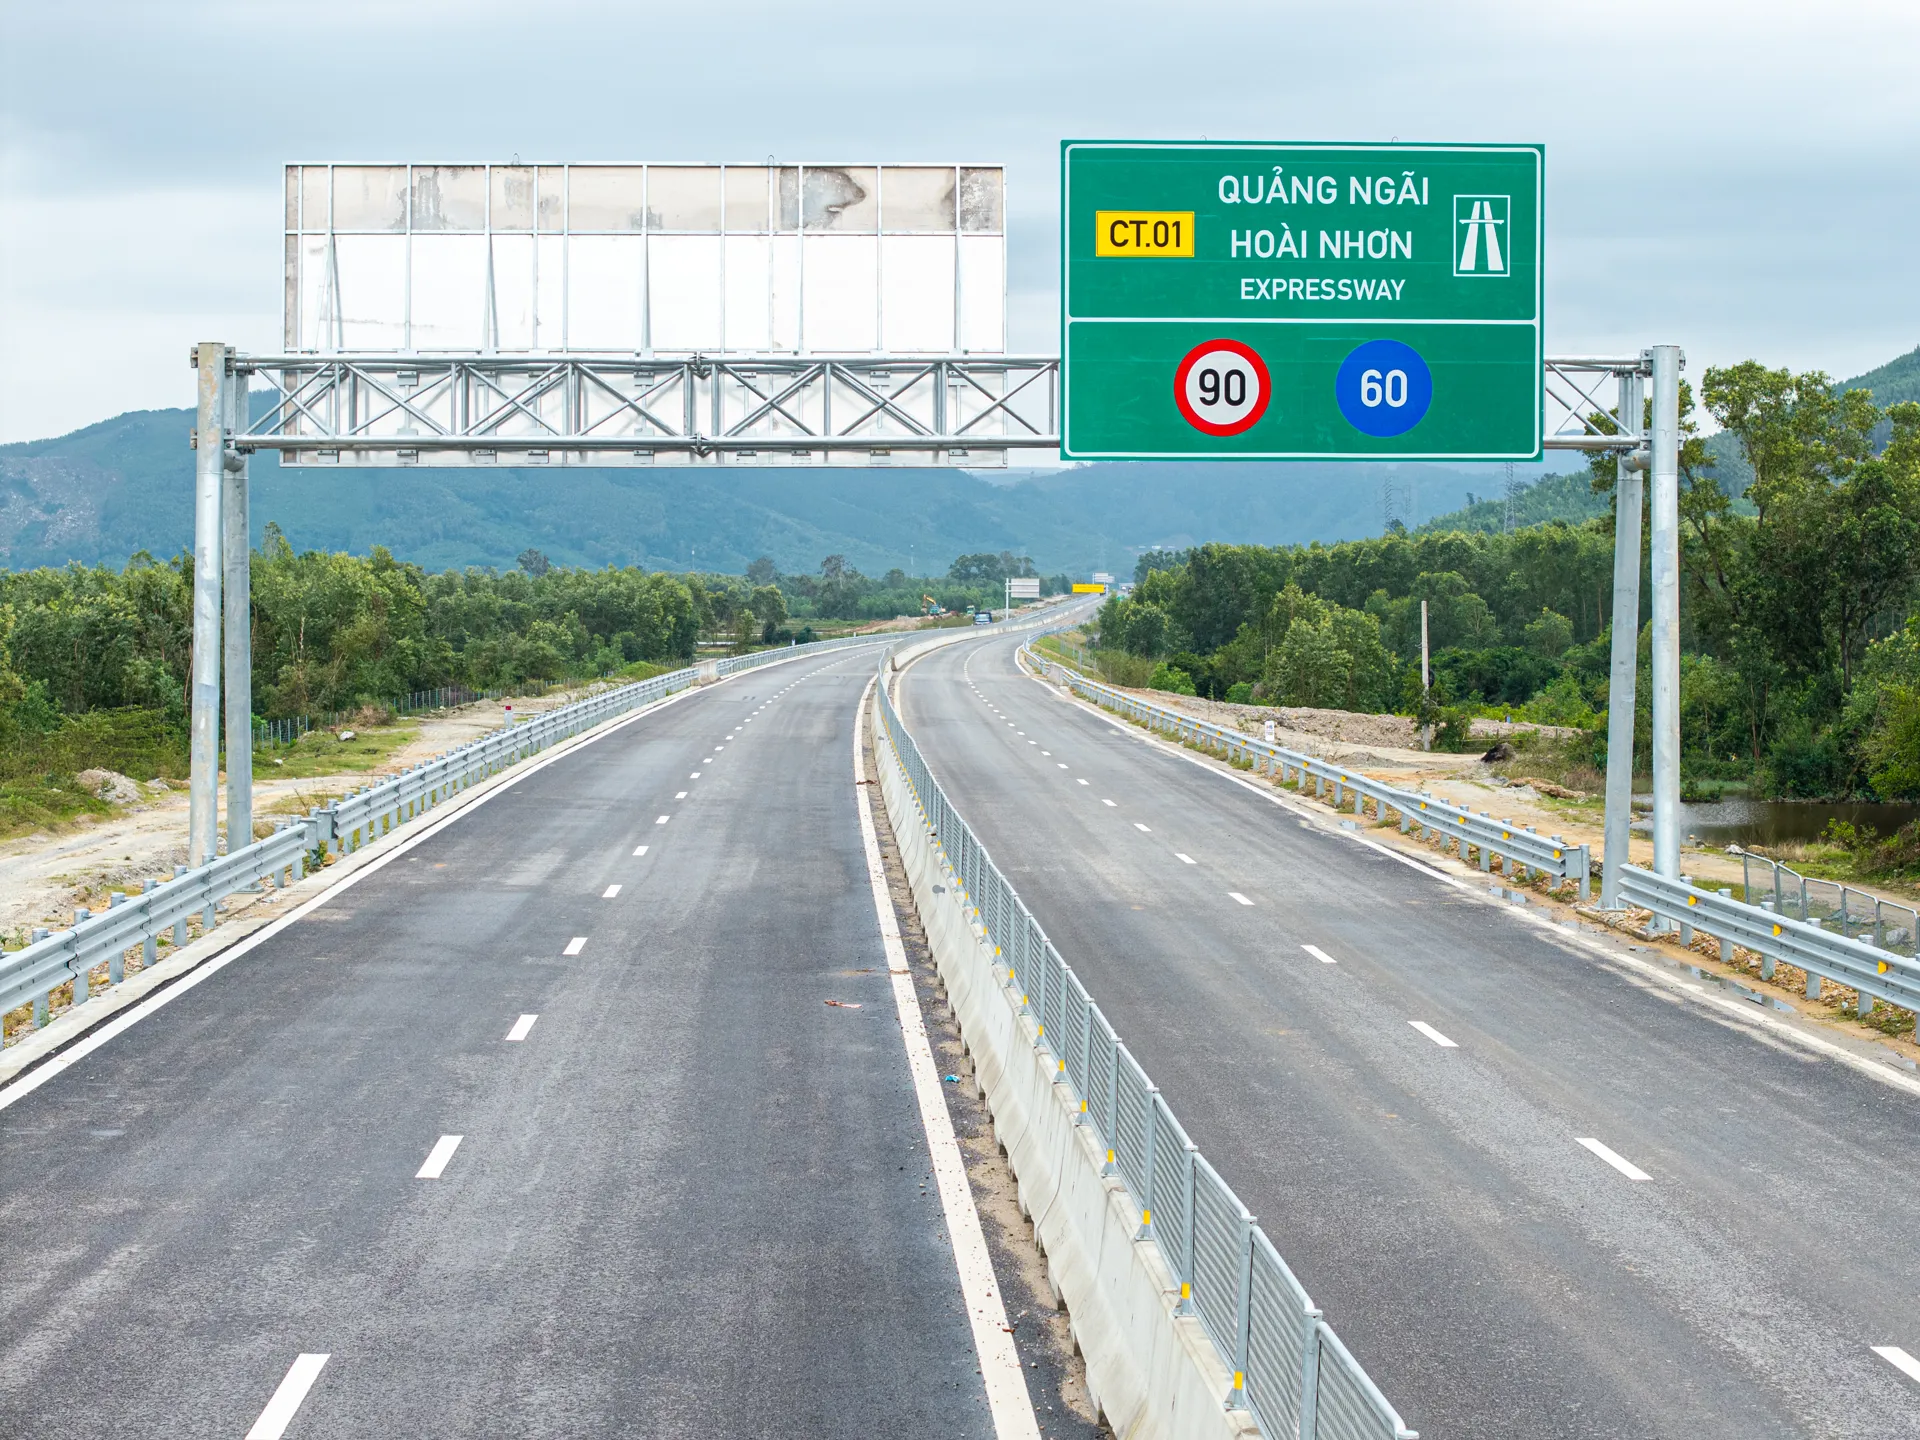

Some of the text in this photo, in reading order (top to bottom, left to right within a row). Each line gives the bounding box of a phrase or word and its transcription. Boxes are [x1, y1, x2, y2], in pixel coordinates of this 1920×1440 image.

[1218, 165, 1429, 205] QUẢNG NGÃI
[1110, 219, 1181, 248] CT.01
[1231, 222, 1412, 259] HOÀI NHƠN
[1240, 278, 1406, 301] EXPRESSWAY
[1198, 368, 1246, 407] 90
[1361, 369, 1408, 408] 60
